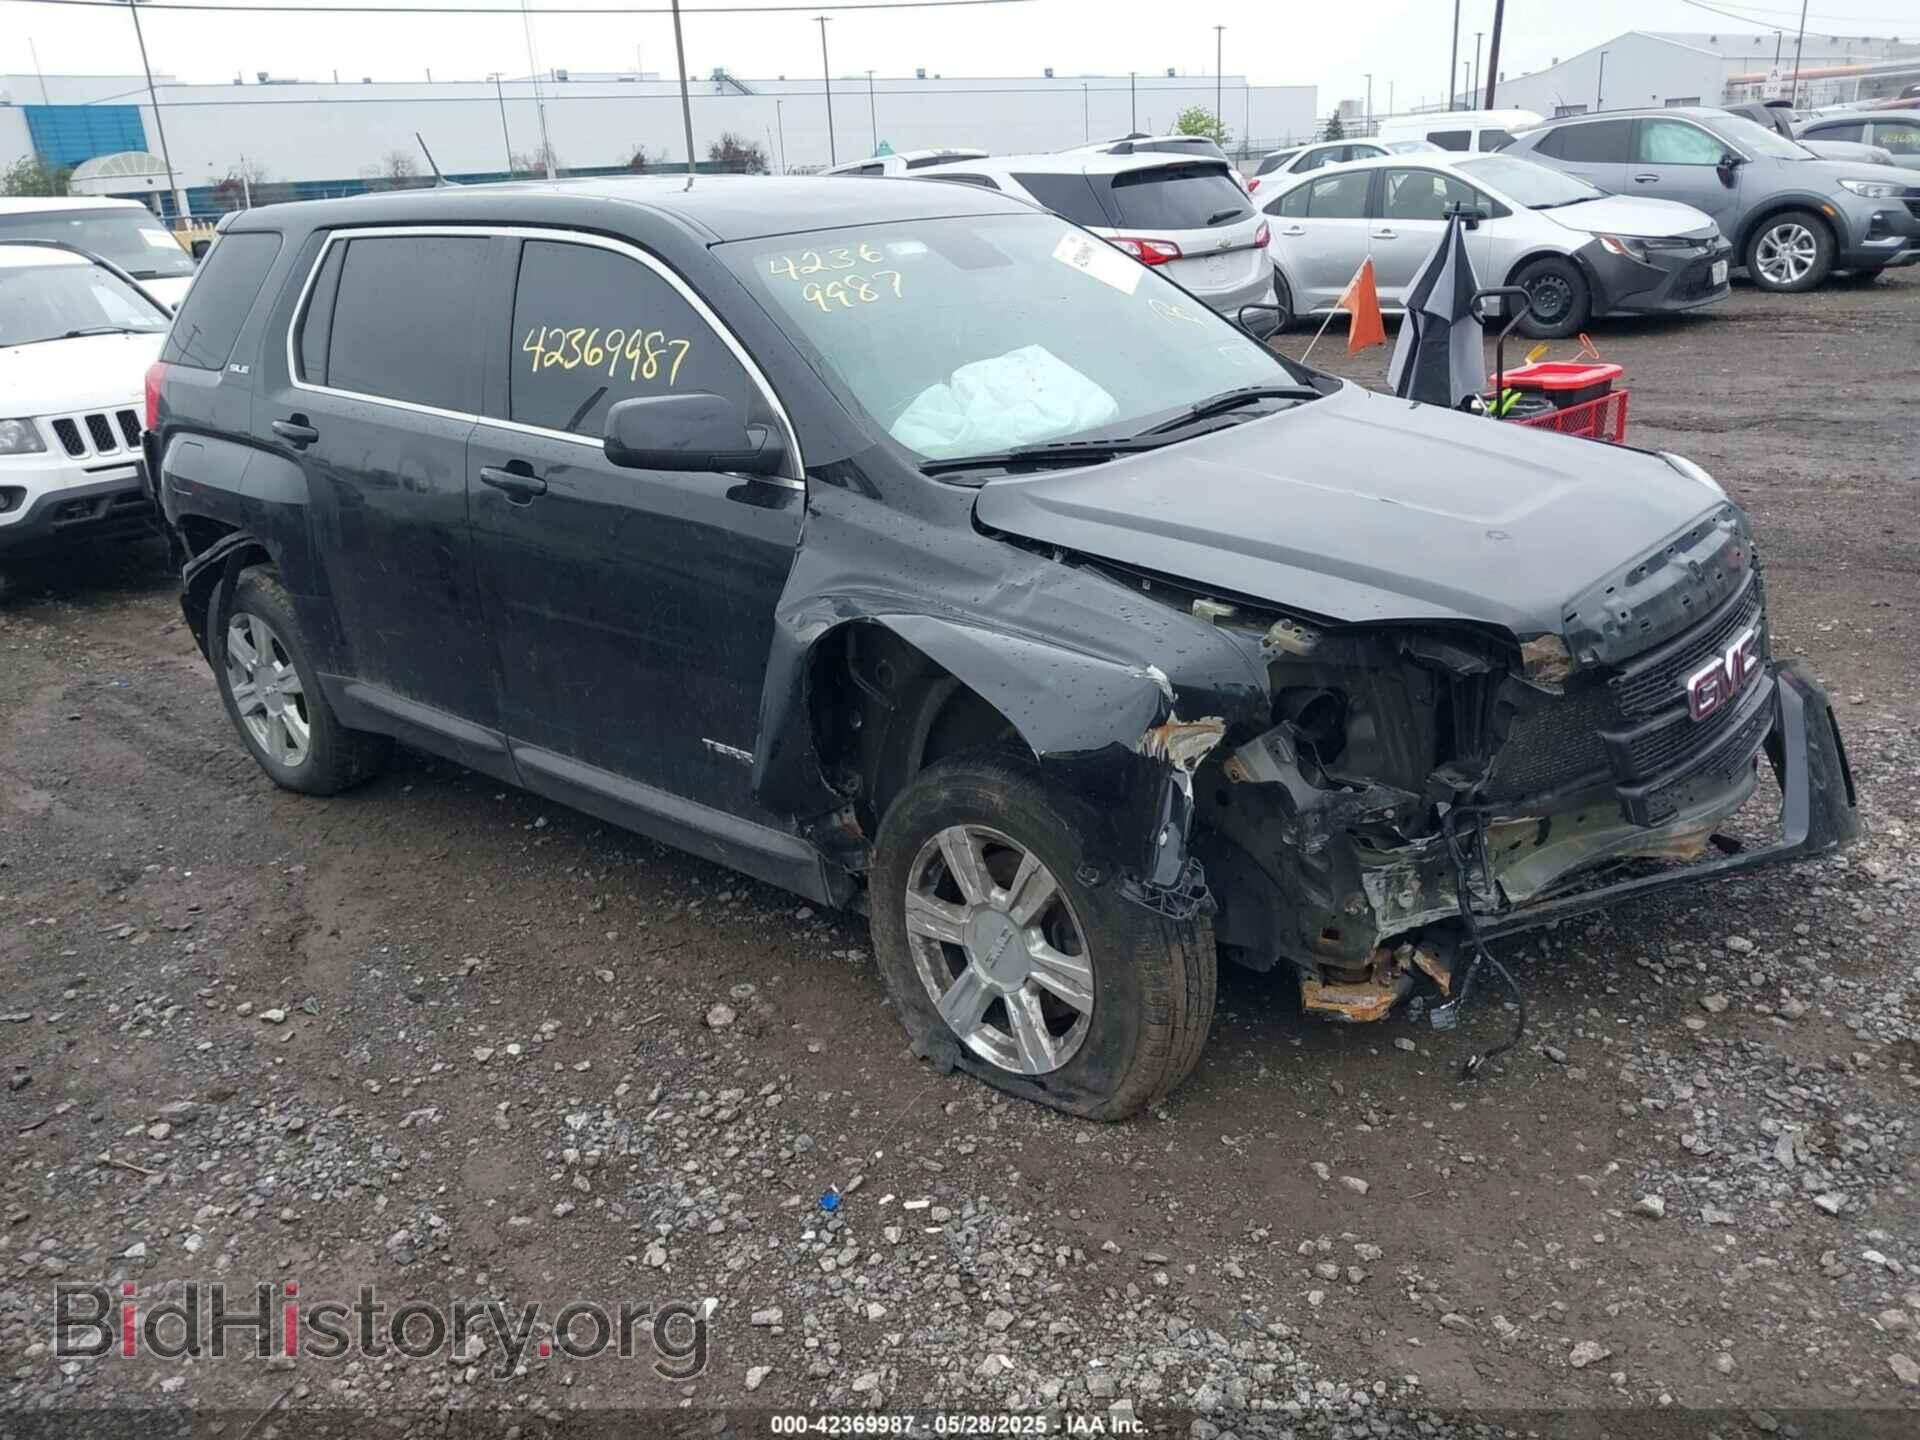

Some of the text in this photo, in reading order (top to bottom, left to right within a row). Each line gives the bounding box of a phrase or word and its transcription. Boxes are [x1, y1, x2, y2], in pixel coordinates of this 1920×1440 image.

[769, 242, 884, 281] 4236
[802, 269, 903, 313] 9987
[522, 325, 691, 387] 42369987
[1687, 628, 1758, 721] GMC
